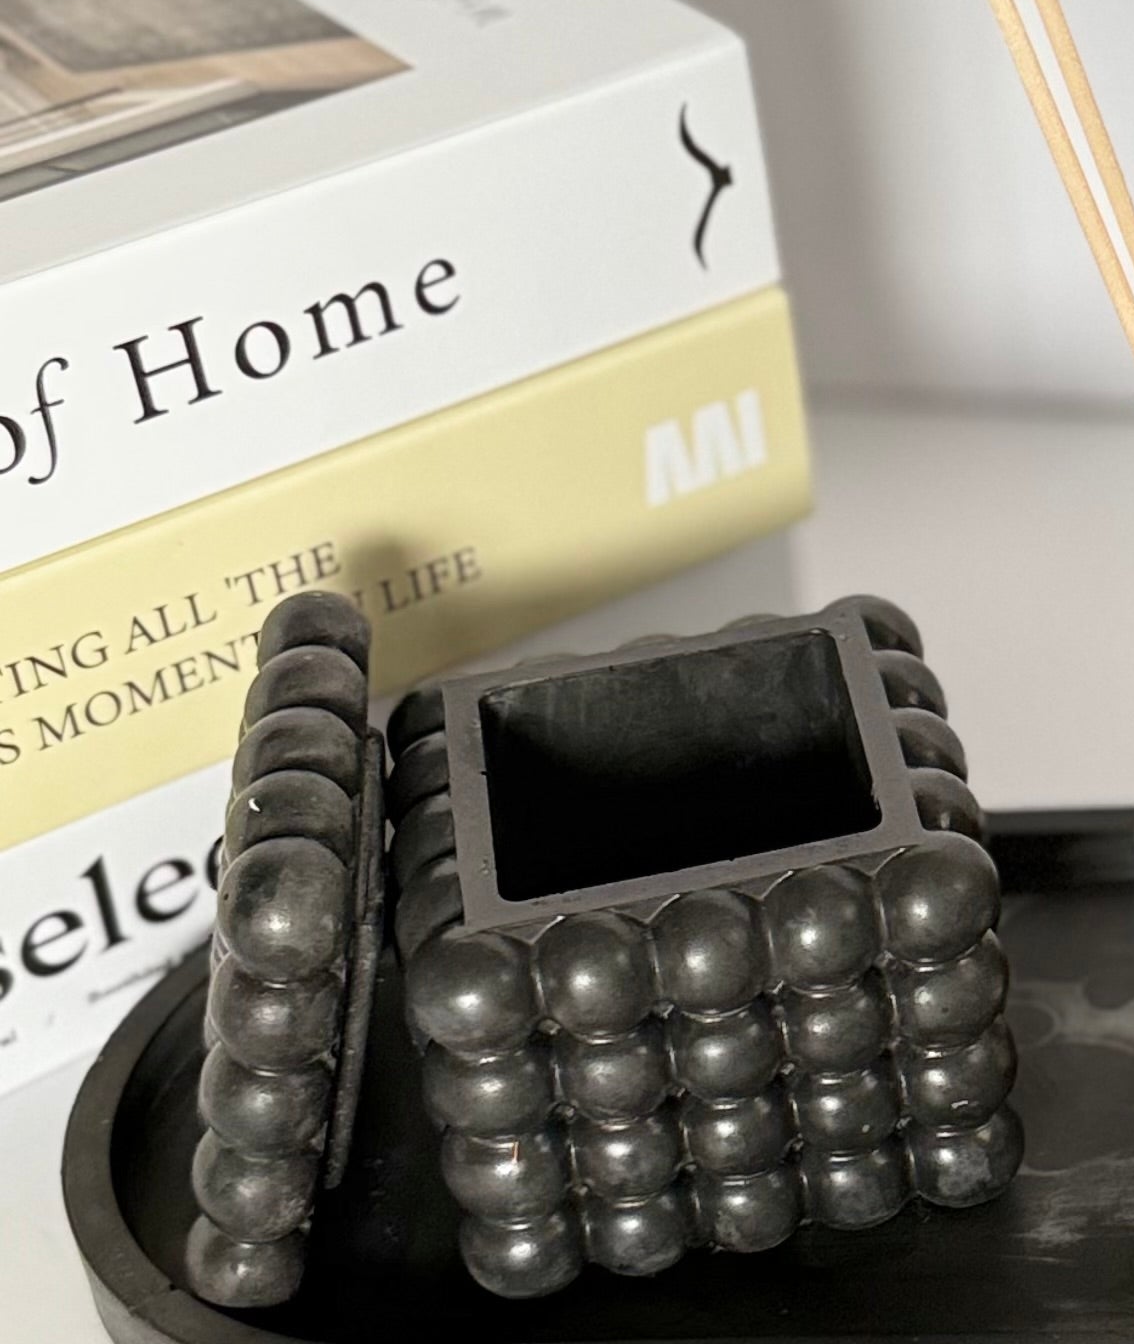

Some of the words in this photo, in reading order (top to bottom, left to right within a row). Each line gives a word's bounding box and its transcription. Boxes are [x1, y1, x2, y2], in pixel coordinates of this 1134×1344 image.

[112, 258, 462, 425] Home
[0, 630, 109, 704] ING
[124, 593, 218, 655] ALL
[224, 541, 343, 608] 'THE
[379, 546, 483, 614] LIFE
[0, 834, 225, 1002] ele
